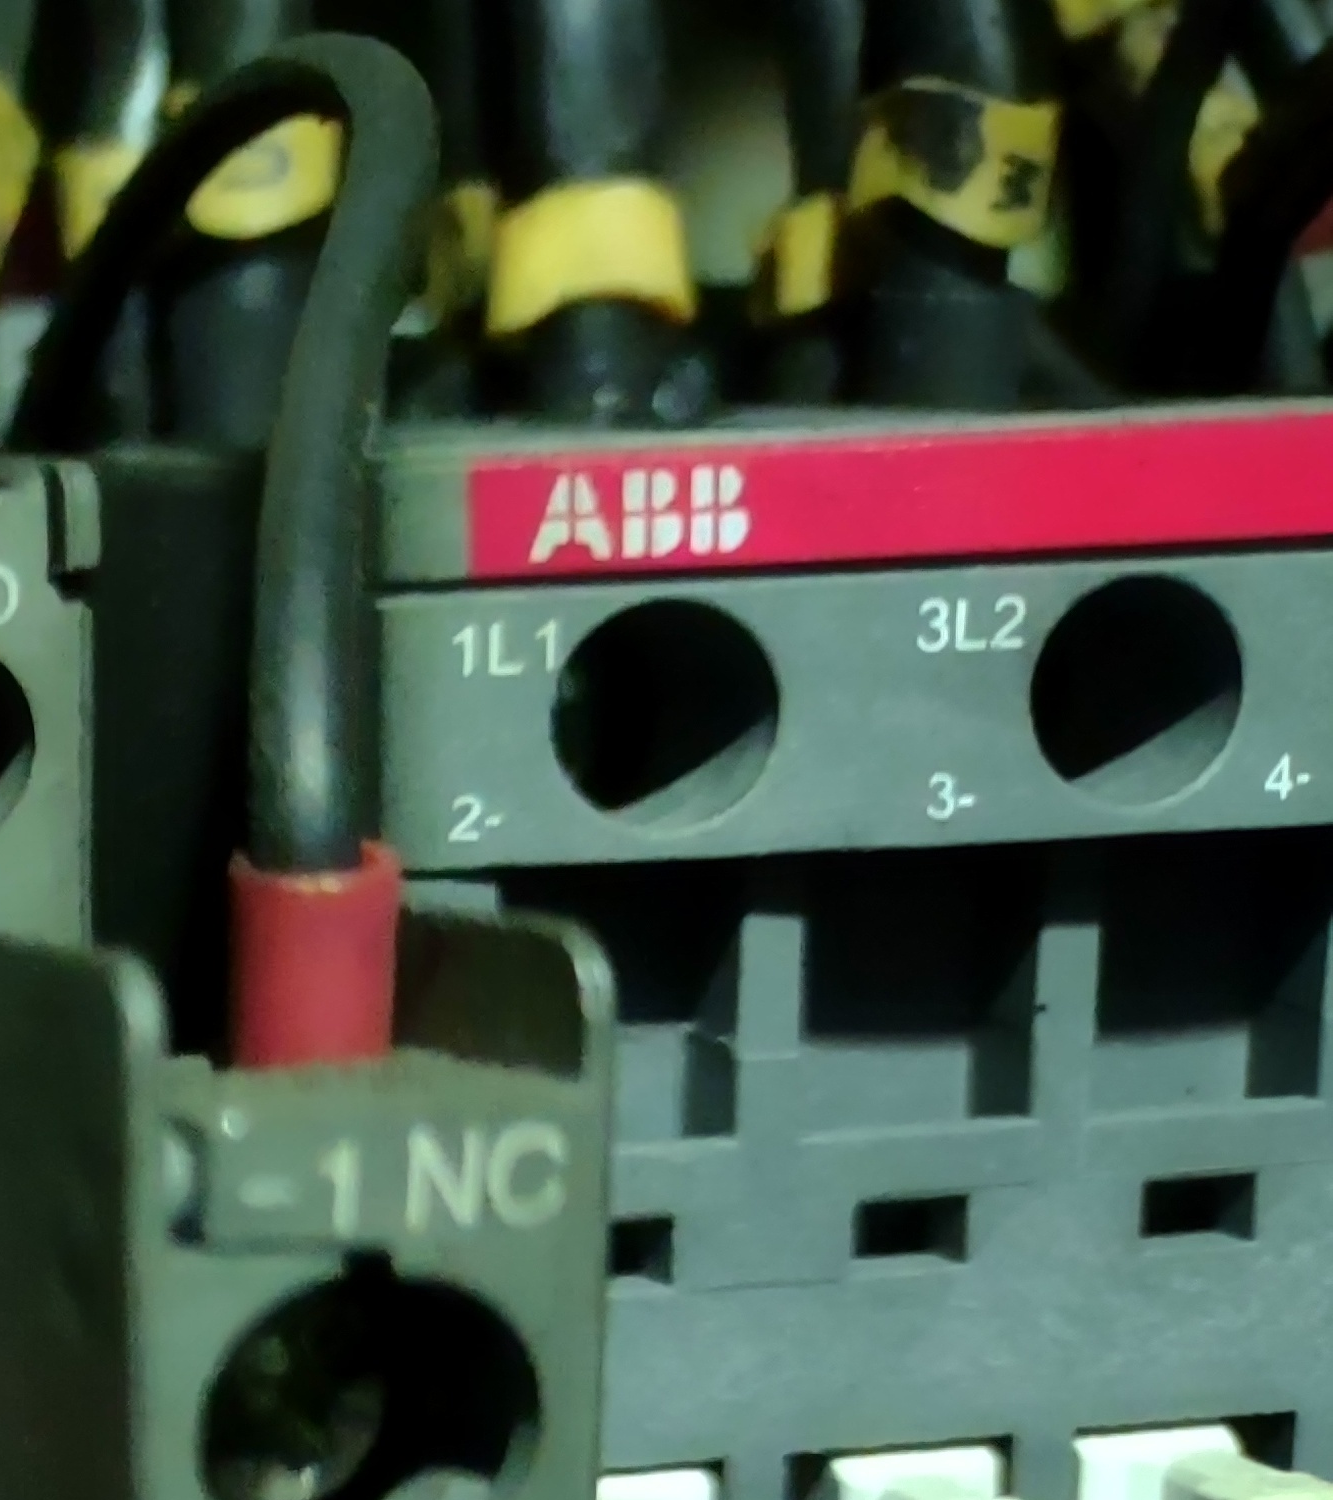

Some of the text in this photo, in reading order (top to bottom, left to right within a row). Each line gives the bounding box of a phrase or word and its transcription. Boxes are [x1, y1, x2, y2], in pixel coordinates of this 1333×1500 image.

[530, 466, 751, 562] ABB
[451, 620, 559, 678] 1L1
[917, 595, 1028, 654] 3L2
[926, 772, 975, 820] 3-
[1263, 754, 1312, 802] 4-
[447, 794, 503, 842] 2-
[404, 1120, 567, 1233] NC
